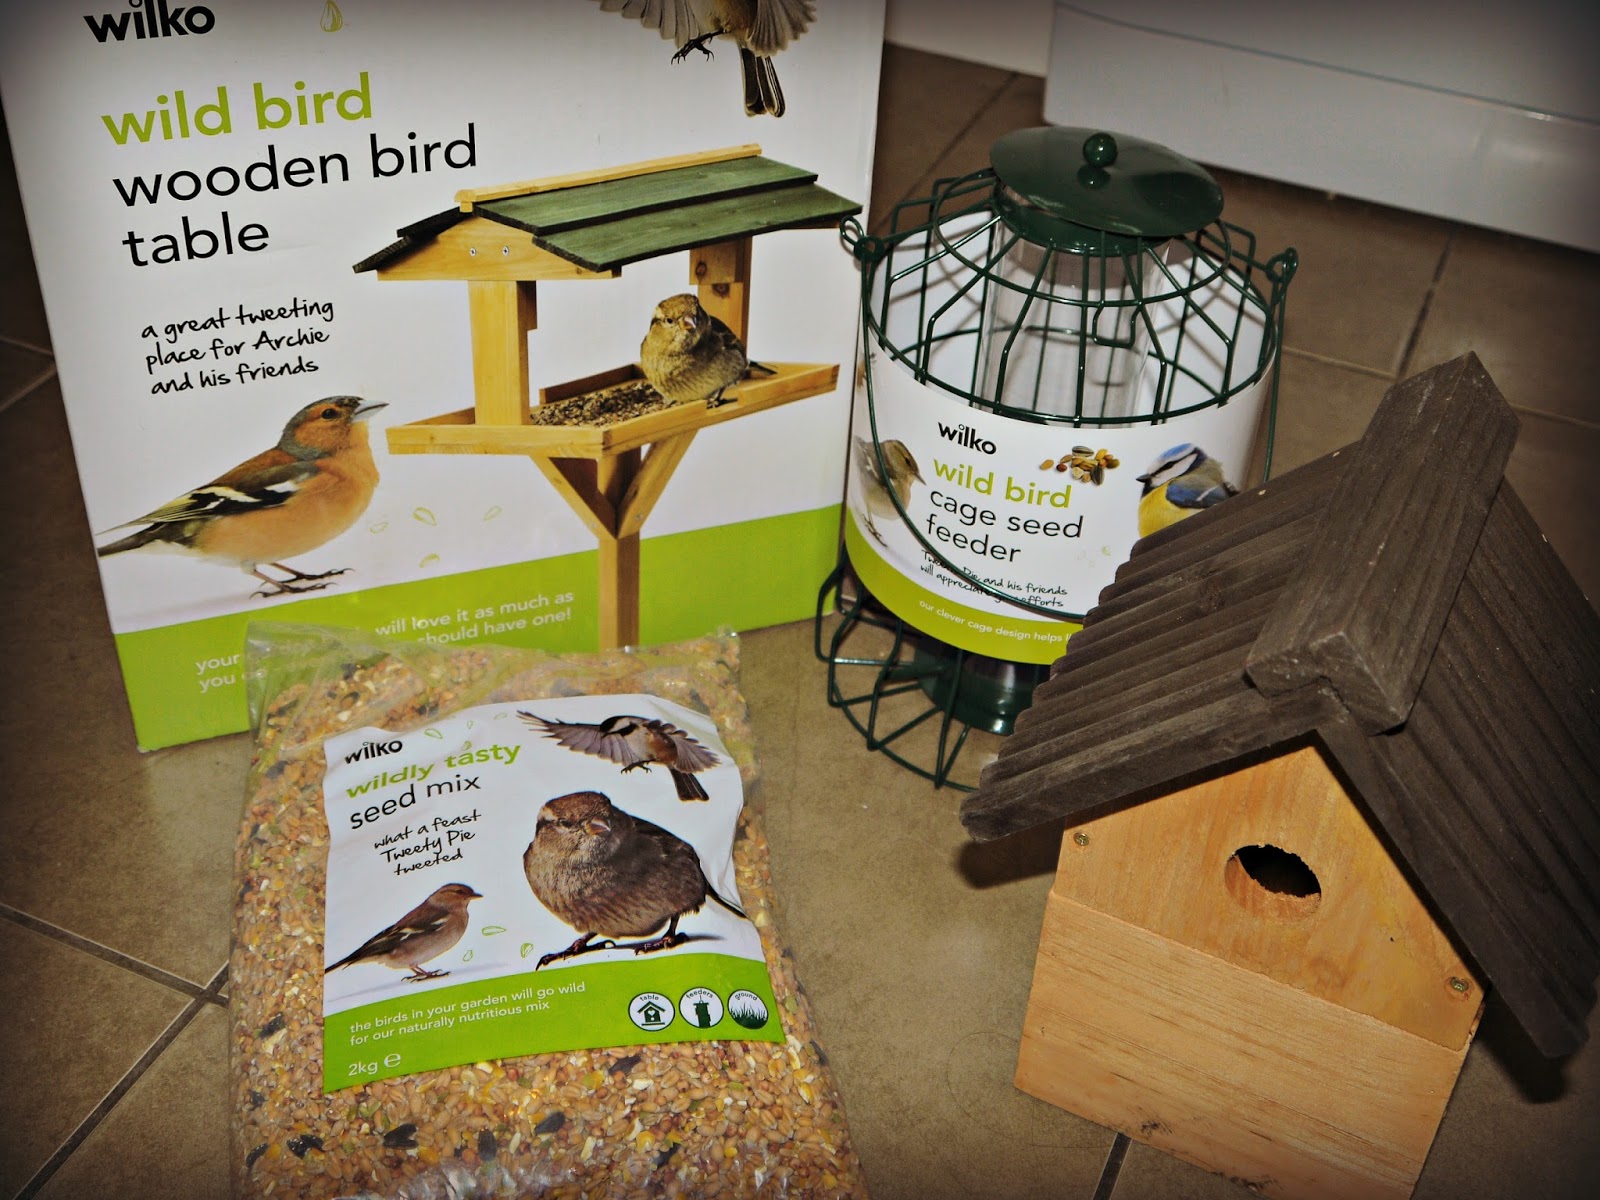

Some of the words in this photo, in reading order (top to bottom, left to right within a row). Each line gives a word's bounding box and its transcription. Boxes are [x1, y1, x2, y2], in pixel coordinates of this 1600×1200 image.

[83, 0, 216, 43] wilko
[101, 86, 232, 146] wild
[253, 71, 372, 131] bird
[113, 145, 349, 207] wooden
[370, 122, 477, 179] bird
[122, 211, 269, 268] table
[141, 325, 158, 338] a
[164, 307, 230, 344] great
[235, 297, 334, 322] tweeting
[146, 341, 206, 375] place
[209, 338, 245, 359] for
[252, 327, 330, 351] Archie
[151, 372, 194, 394] and
[200, 369, 231, 388] his
[235, 355, 319, 384] friends
[937, 421, 997, 455] wilko
[933, 458, 994, 496] wild
[1005, 476, 1072, 509] bird
[930, 490, 997, 526] cage
[1007, 515, 1084, 539] seed
[926, 514, 1021, 563] feeder
[920, 563, 935, 577] will
[983, 577, 1004, 588] and
[1007, 580, 1023, 591] his
[1025, 582, 1068, 596] friends
[195, 654, 240, 676] your
[375, 618, 406, 636] will
[412, 614, 451, 631] love
[457, 608, 469, 623] it
[474, 607, 495, 620] as
[500, 594, 549, 614] much
[554, 592, 574, 605] as
[919, 600, 935, 612] our
[936, 608, 966, 625] clever
[967, 620, 993, 633] cage
[995, 626, 1031, 641] design
[1033, 632, 1063, 643] helps
[199, 674, 236, 694] you
[484, 621, 527, 636] have
[532, 607, 571, 626] one!
[344, 740, 403, 764] wilko
[346, 763, 435, 799] wildly
[444, 744, 521, 770] tasty
[350, 783, 416, 830] seed
[426, 774, 481, 798] mix
[374, 825, 413, 849] what
[417, 824, 429, 834] a
[432, 809, 482, 832] feast
[380, 836, 441, 864] Tweety
[447, 829, 475, 847] Pie
[393, 848, 463, 876] tweeted
[350, 1022, 371, 1033] the
[375, 1011, 408, 1028] birds
[412, 1008, 423, 1019] in
[427, 1003, 456, 1022] your
[461, 993, 508, 1011] garden
[511, 987, 533, 1001] will
[537, 986, 555, 1000] go
[558, 981, 586, 995] wild
[686, 989, 714, 999] feeders
[734, 991, 758, 1001] ground
[350, 1034, 368, 1046] for
[373, 1028, 395, 1040] our
[399, 1016, 455, 1035] naturally
[459, 1004, 522, 1023] nutritious
[526, 1000, 550, 1013] mix
[348, 1059, 378, 1077] 2kg
